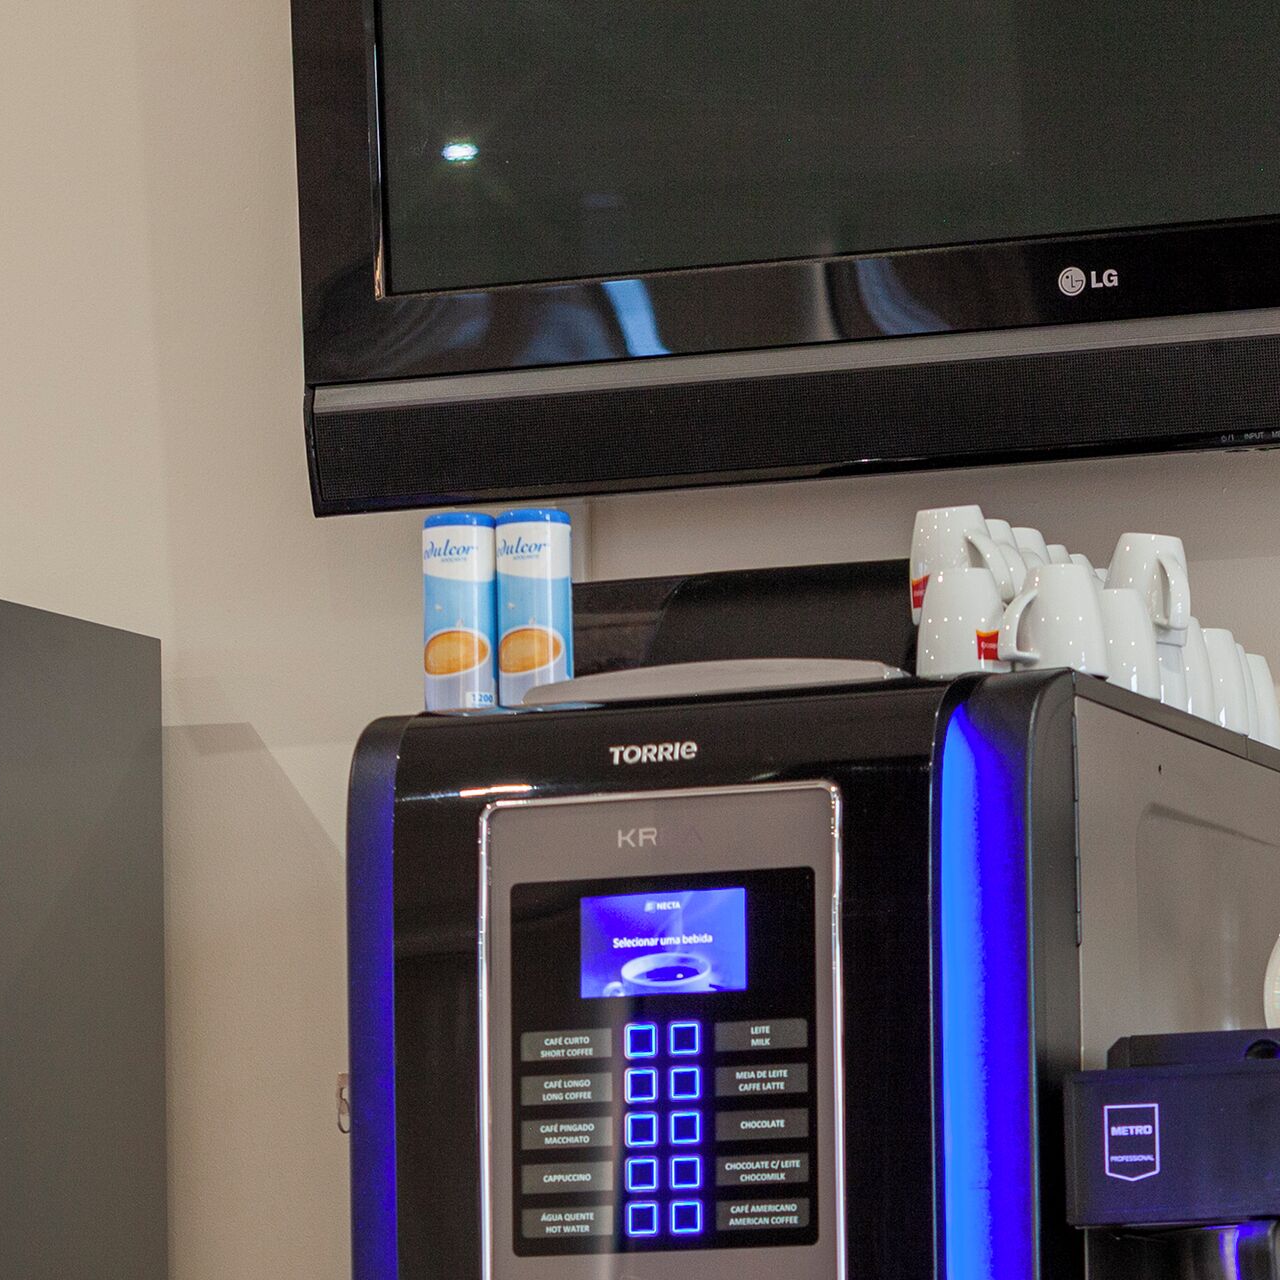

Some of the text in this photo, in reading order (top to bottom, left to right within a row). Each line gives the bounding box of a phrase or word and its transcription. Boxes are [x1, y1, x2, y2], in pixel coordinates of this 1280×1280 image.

[1090, 269, 1118, 288] LG
[656, 901, 681, 910] NECTA
[612, 933, 713, 949] Selecionar uma bebida
[750, 1025, 770, 1034] LEITE
[564, 1036, 590, 1044] CURTO
[750, 1038, 770, 1046] MILK
[540, 1048, 594, 1058] SHORT COFFEE
[735, 1069, 788, 1080] MEIA DE LEITE
[564, 1079, 591, 1088] LONGO
[762, 1082, 785, 1090] LATTE
[542, 1091, 592, 1102] LONG COFFEE
[560, 1123, 594, 1132] PINGADO
[740, 1120, 785, 1129] CHOCOLATE
[1110, 1125, 1152, 1136] METRO
[544, 1136, 590, 1144] MACCHIATO
[725, 1160, 770, 1170] CHOCOLATE
[780, 1160, 800, 1168] LEITE
[543, 1174, 592, 1182] CAPPUCCINO
[740, 1172, 786, 1182] CHOCOMILK
[750, 1204, 798, 1213] AMERICANO
[564, 1212, 594, 1222] QUENTE
[728, 1216, 799, 1226] AMERICAN COFFEE
[546, 1225, 590, 1234] HOT WATER
